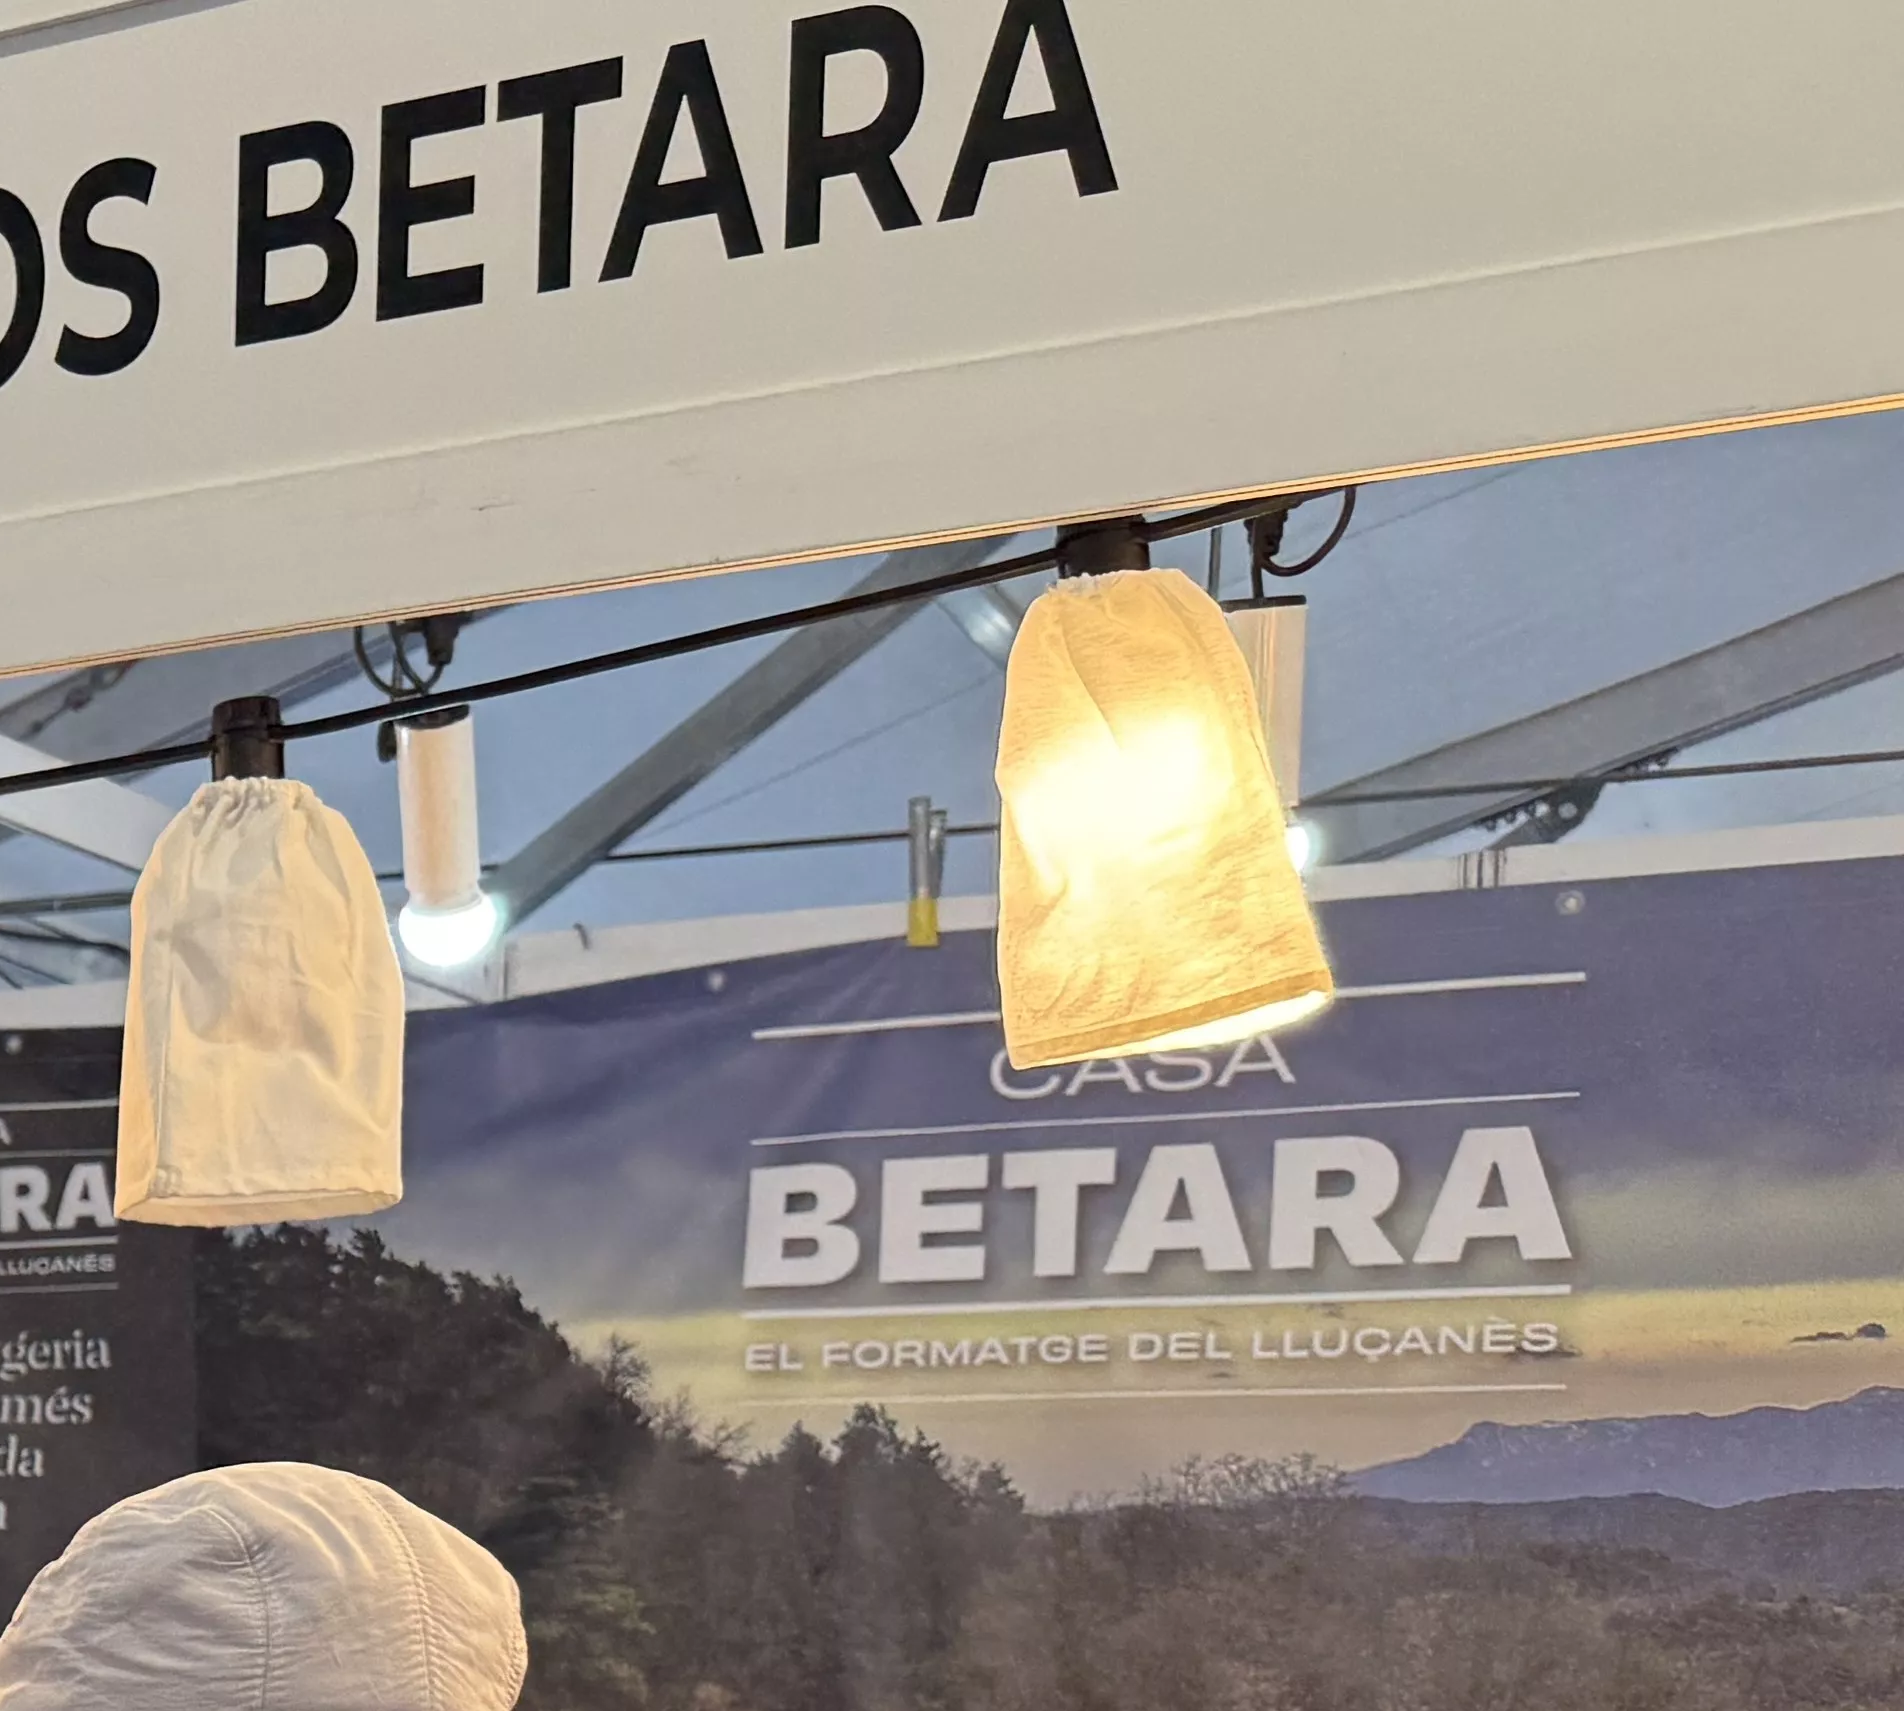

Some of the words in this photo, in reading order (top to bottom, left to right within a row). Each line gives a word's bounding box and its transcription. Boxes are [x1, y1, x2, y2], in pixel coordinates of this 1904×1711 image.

[234, 0, 1120, 348] BETARA
[742, 1125, 1574, 1290] BETARA
[744, 1343, 804, 1371] EL
[822, 1334, 1108, 1369] FORMATGE
[1127, 1331, 1233, 1361] DEL
[1252, 1315, 1559, 1362] LLUÇANÈS
